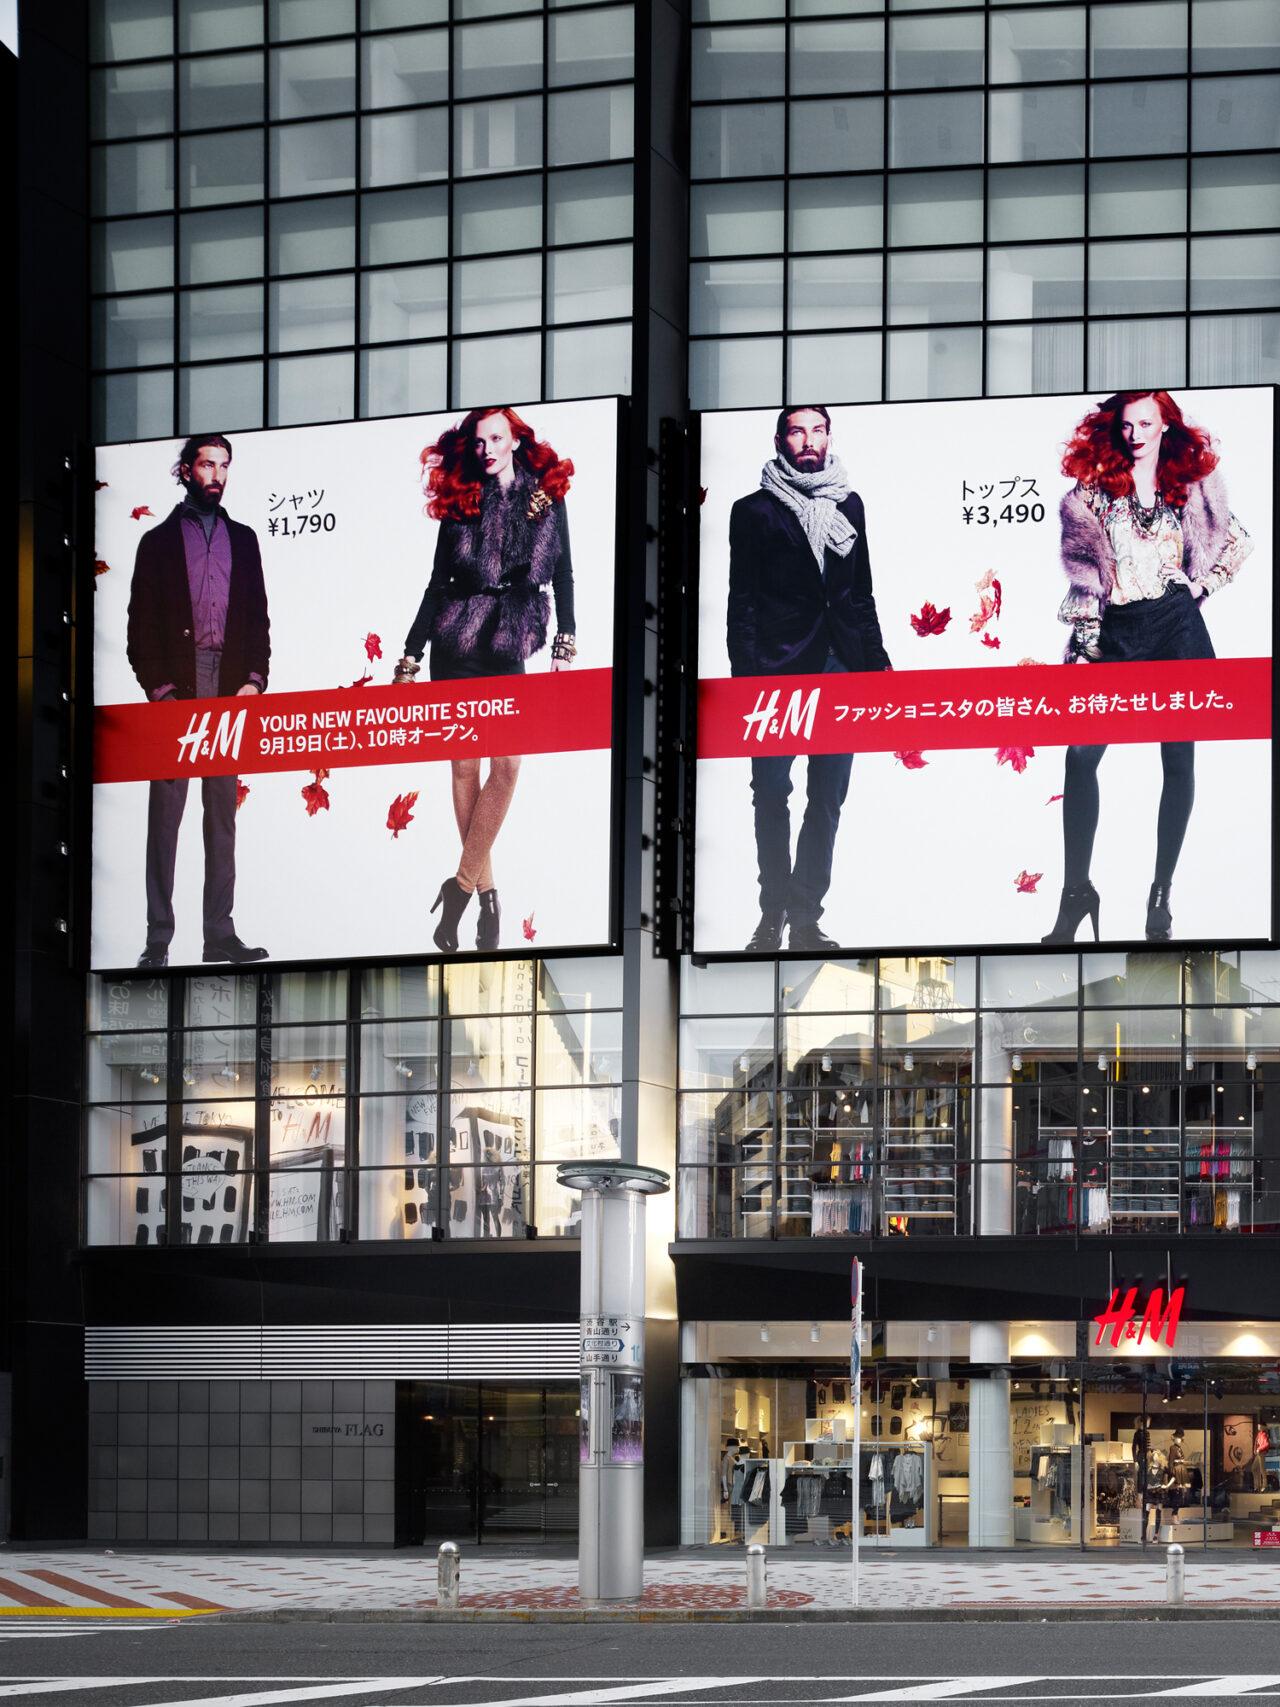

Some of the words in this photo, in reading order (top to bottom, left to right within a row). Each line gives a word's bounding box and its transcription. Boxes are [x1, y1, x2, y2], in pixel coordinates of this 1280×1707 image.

[268, 489, 326, 512] シャツ
[962, 475, 1040, 500] トップス
[268, 512, 337, 538] ¥1,790
[962, 504, 1045, 528] ¥3,490
[259, 713, 307, 733] YOUR
[312, 710, 352, 730] NEW
[356, 703, 452, 727] FAVOURITE
[456, 697, 520, 718] STORE.
[743, 687, 821, 743] H&M
[834, 689, 1234, 723] ファッショニスタの皆さん、お待たせしました。
[177, 708, 248, 764] H&M
[1094, 1287, 1185, 1348] H&M
[345, 1423, 384, 1437] FLAG
